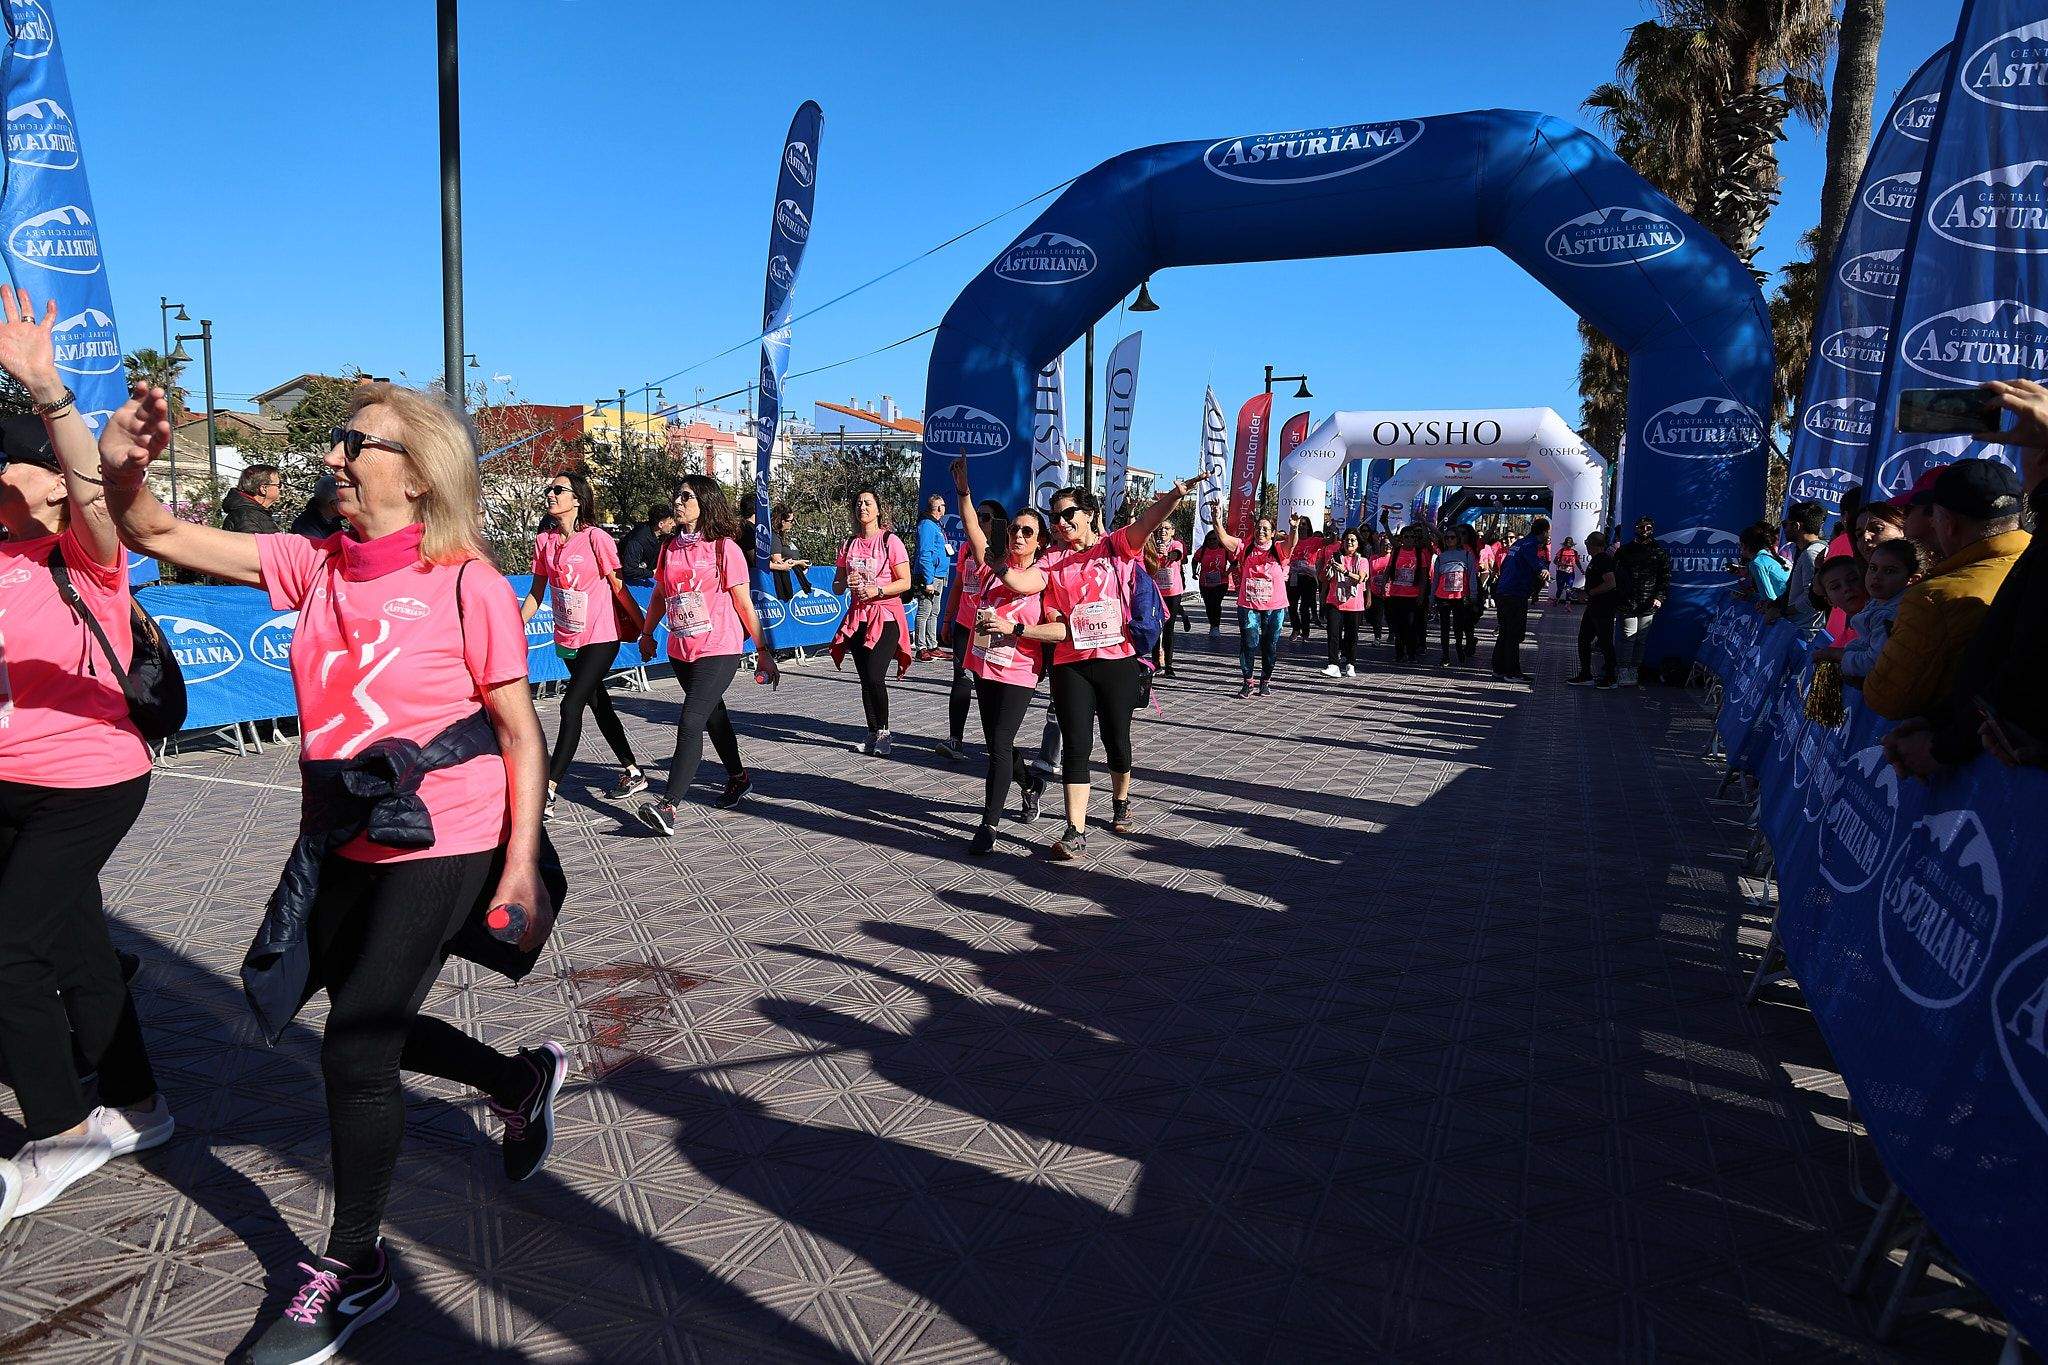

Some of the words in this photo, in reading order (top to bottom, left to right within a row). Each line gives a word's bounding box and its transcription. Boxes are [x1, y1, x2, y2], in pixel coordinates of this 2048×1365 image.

[1256, 130, 1324, 142] CENTRAL
[1218, 127, 1406, 168] ASTURIANA
[1978, 192, 2040, 202] CENTRAL
[1575, 226, 1621, 237] CENTRAL
[1556, 231, 1676, 257] ASTURIANA
[999, 255, 1089, 273] ASTURIANA
[1913, 329, 2048, 371] ASTURIAN
[1808, 409, 1872, 435] ASTURIA
[926, 424, 1003, 447] ASTURIANA
[1372, 420, 1502, 446] OYSHO
[1650, 421, 1758, 444] ASTURIANA
[1243, 412, 1261, 479] Santander
[1539, 447, 1580, 457] OYSHO
[1299, 449, 1336, 459] OYSHO
[1281, 498, 1315, 507] OYSHO
[1559, 501, 1598, 510] OYSHO
[678, 610, 694, 621] 016
[794, 602, 839, 617] ASTURIANA
[1088, 621, 1108, 631] 016
[181, 637, 225, 646] LECHERA
[173, 646, 236, 666] RIANA
